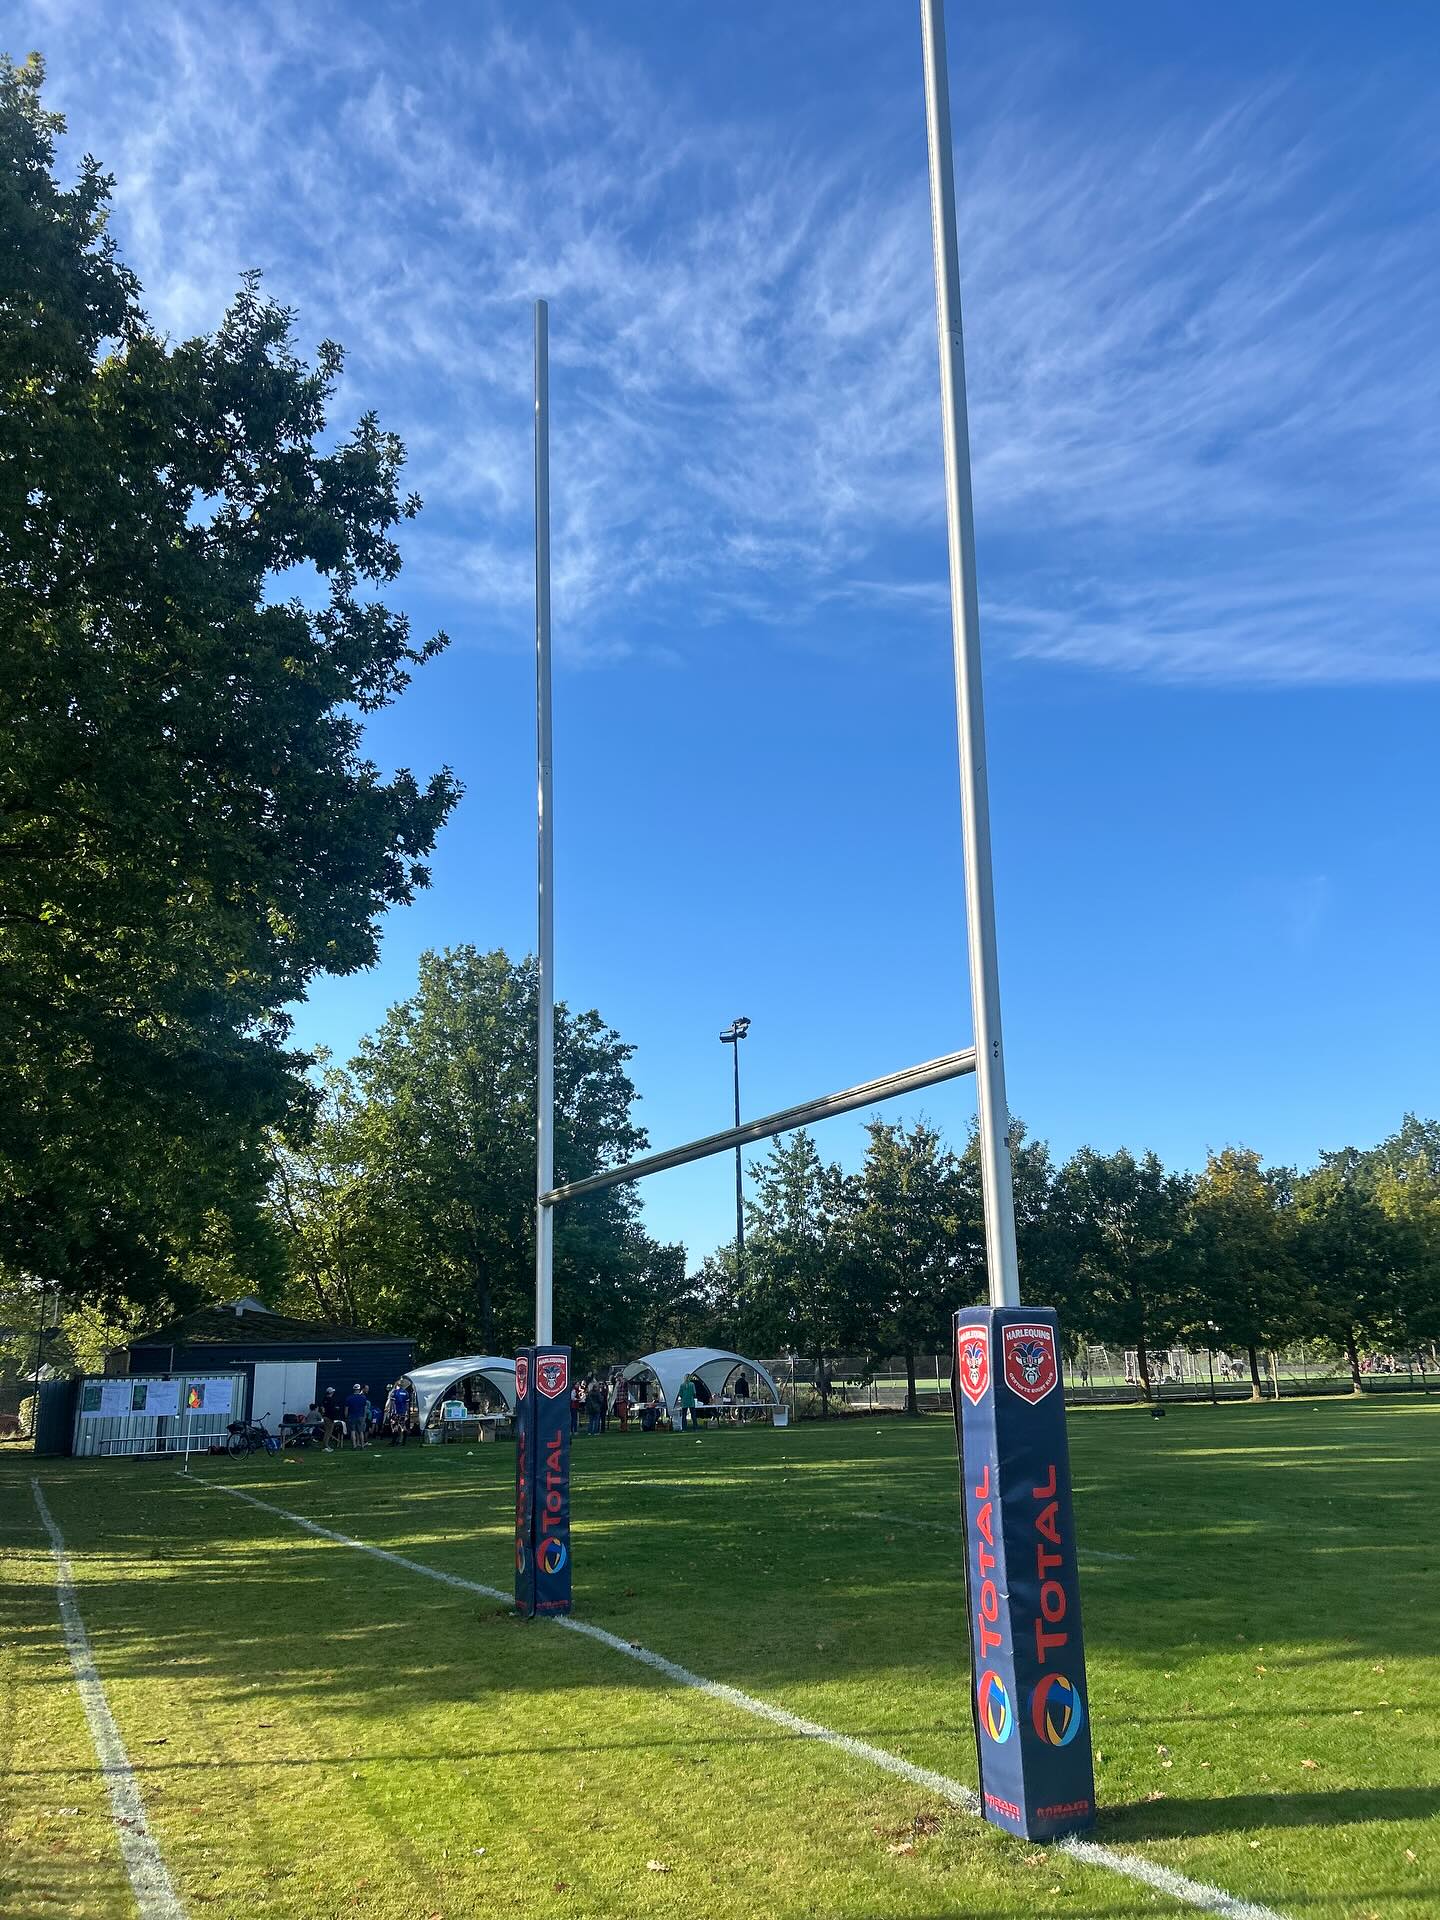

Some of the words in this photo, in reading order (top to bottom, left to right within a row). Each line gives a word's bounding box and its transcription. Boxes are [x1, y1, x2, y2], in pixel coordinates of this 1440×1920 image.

[1006, 1328, 1051, 1340] HARLEQUINS
[542, 1429, 562, 1534] TOTAL
[975, 1465, 1002, 1658] TOTAL
[1033, 1465, 1068, 1664] TOTAL
